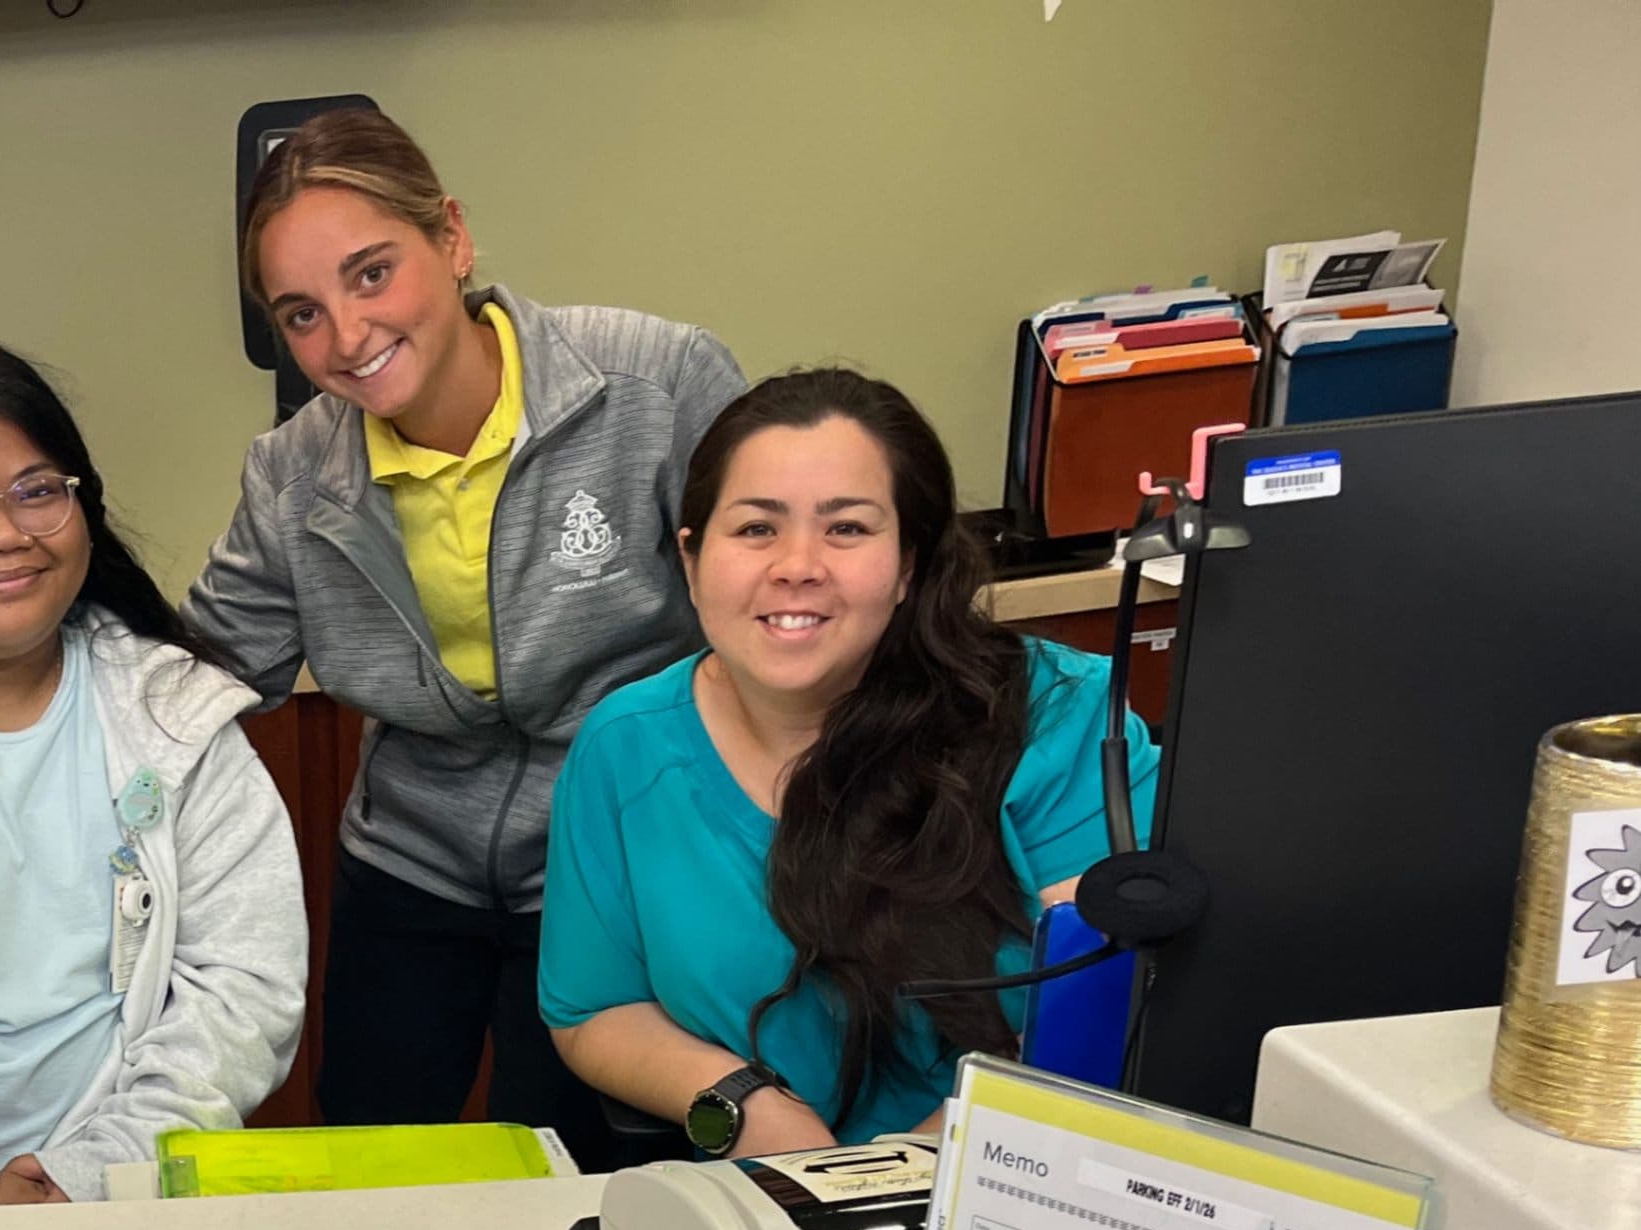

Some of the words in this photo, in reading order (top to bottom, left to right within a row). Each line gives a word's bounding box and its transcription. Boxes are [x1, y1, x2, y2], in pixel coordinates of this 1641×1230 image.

[983, 1141, 1049, 1178] Memo
[1126, 1178, 1165, 1204] PARKING
[1166, 1190, 1183, 1209] EFF
